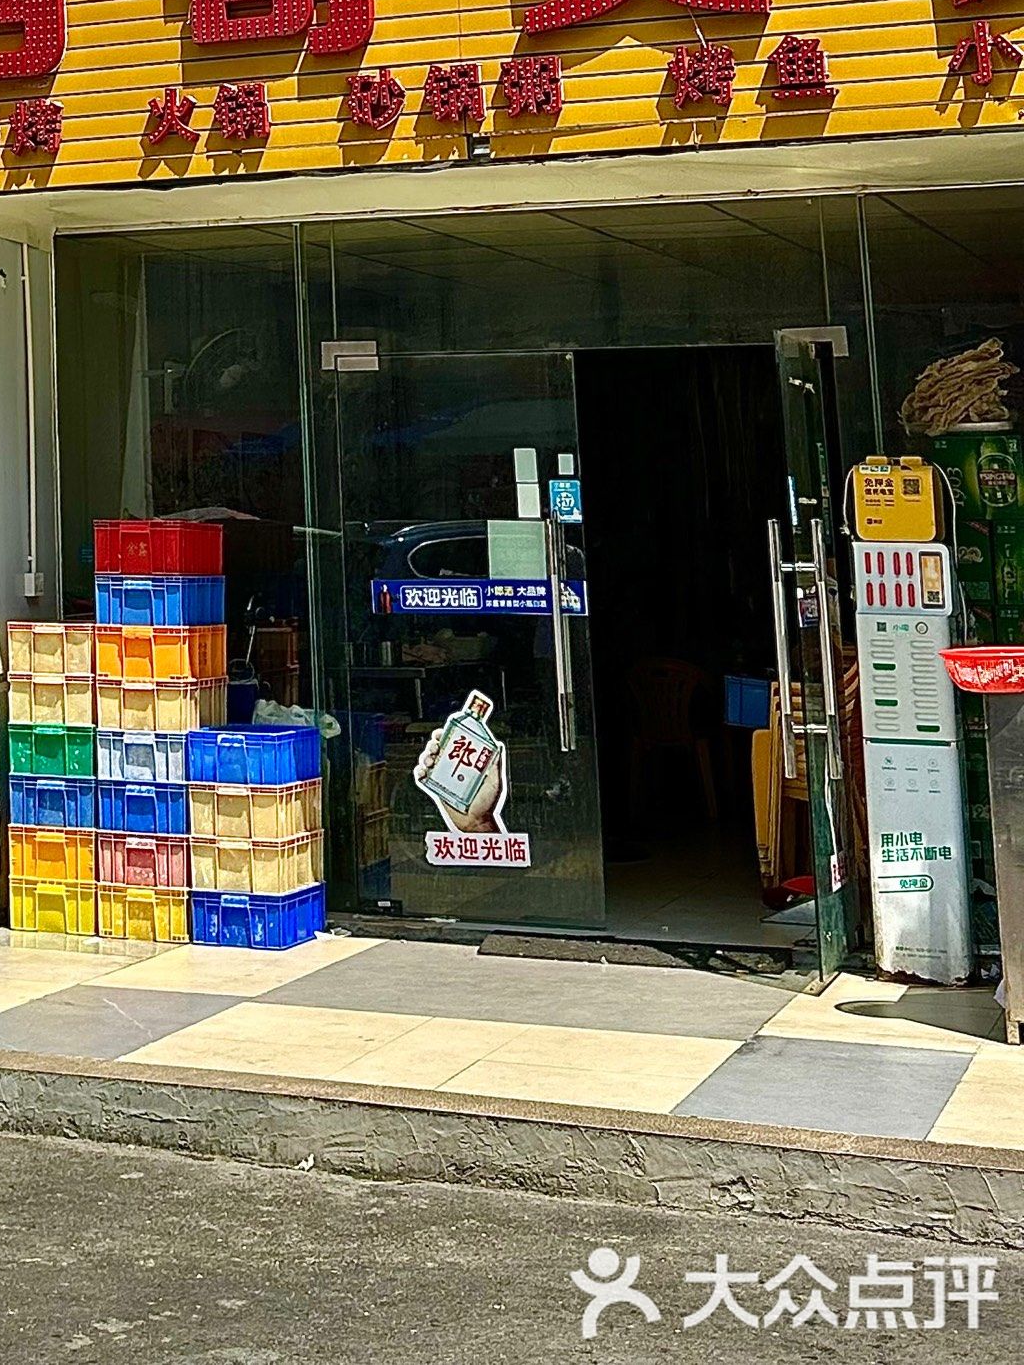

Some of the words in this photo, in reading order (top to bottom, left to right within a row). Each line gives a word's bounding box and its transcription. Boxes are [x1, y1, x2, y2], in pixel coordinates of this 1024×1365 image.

[148, 82, 272, 144] 火锅
[346, 54, 563, 130] 砂锅粥
[667, 35, 840, 110] 烤鱼
[404, 588, 479, 608] 欢迎光临
[447, 734, 477, 777] 郎
[433, 836, 527, 862] 欢迎光临
[880, 831, 924, 848] 用小电
[881, 845, 952, 863] 生活不断电
